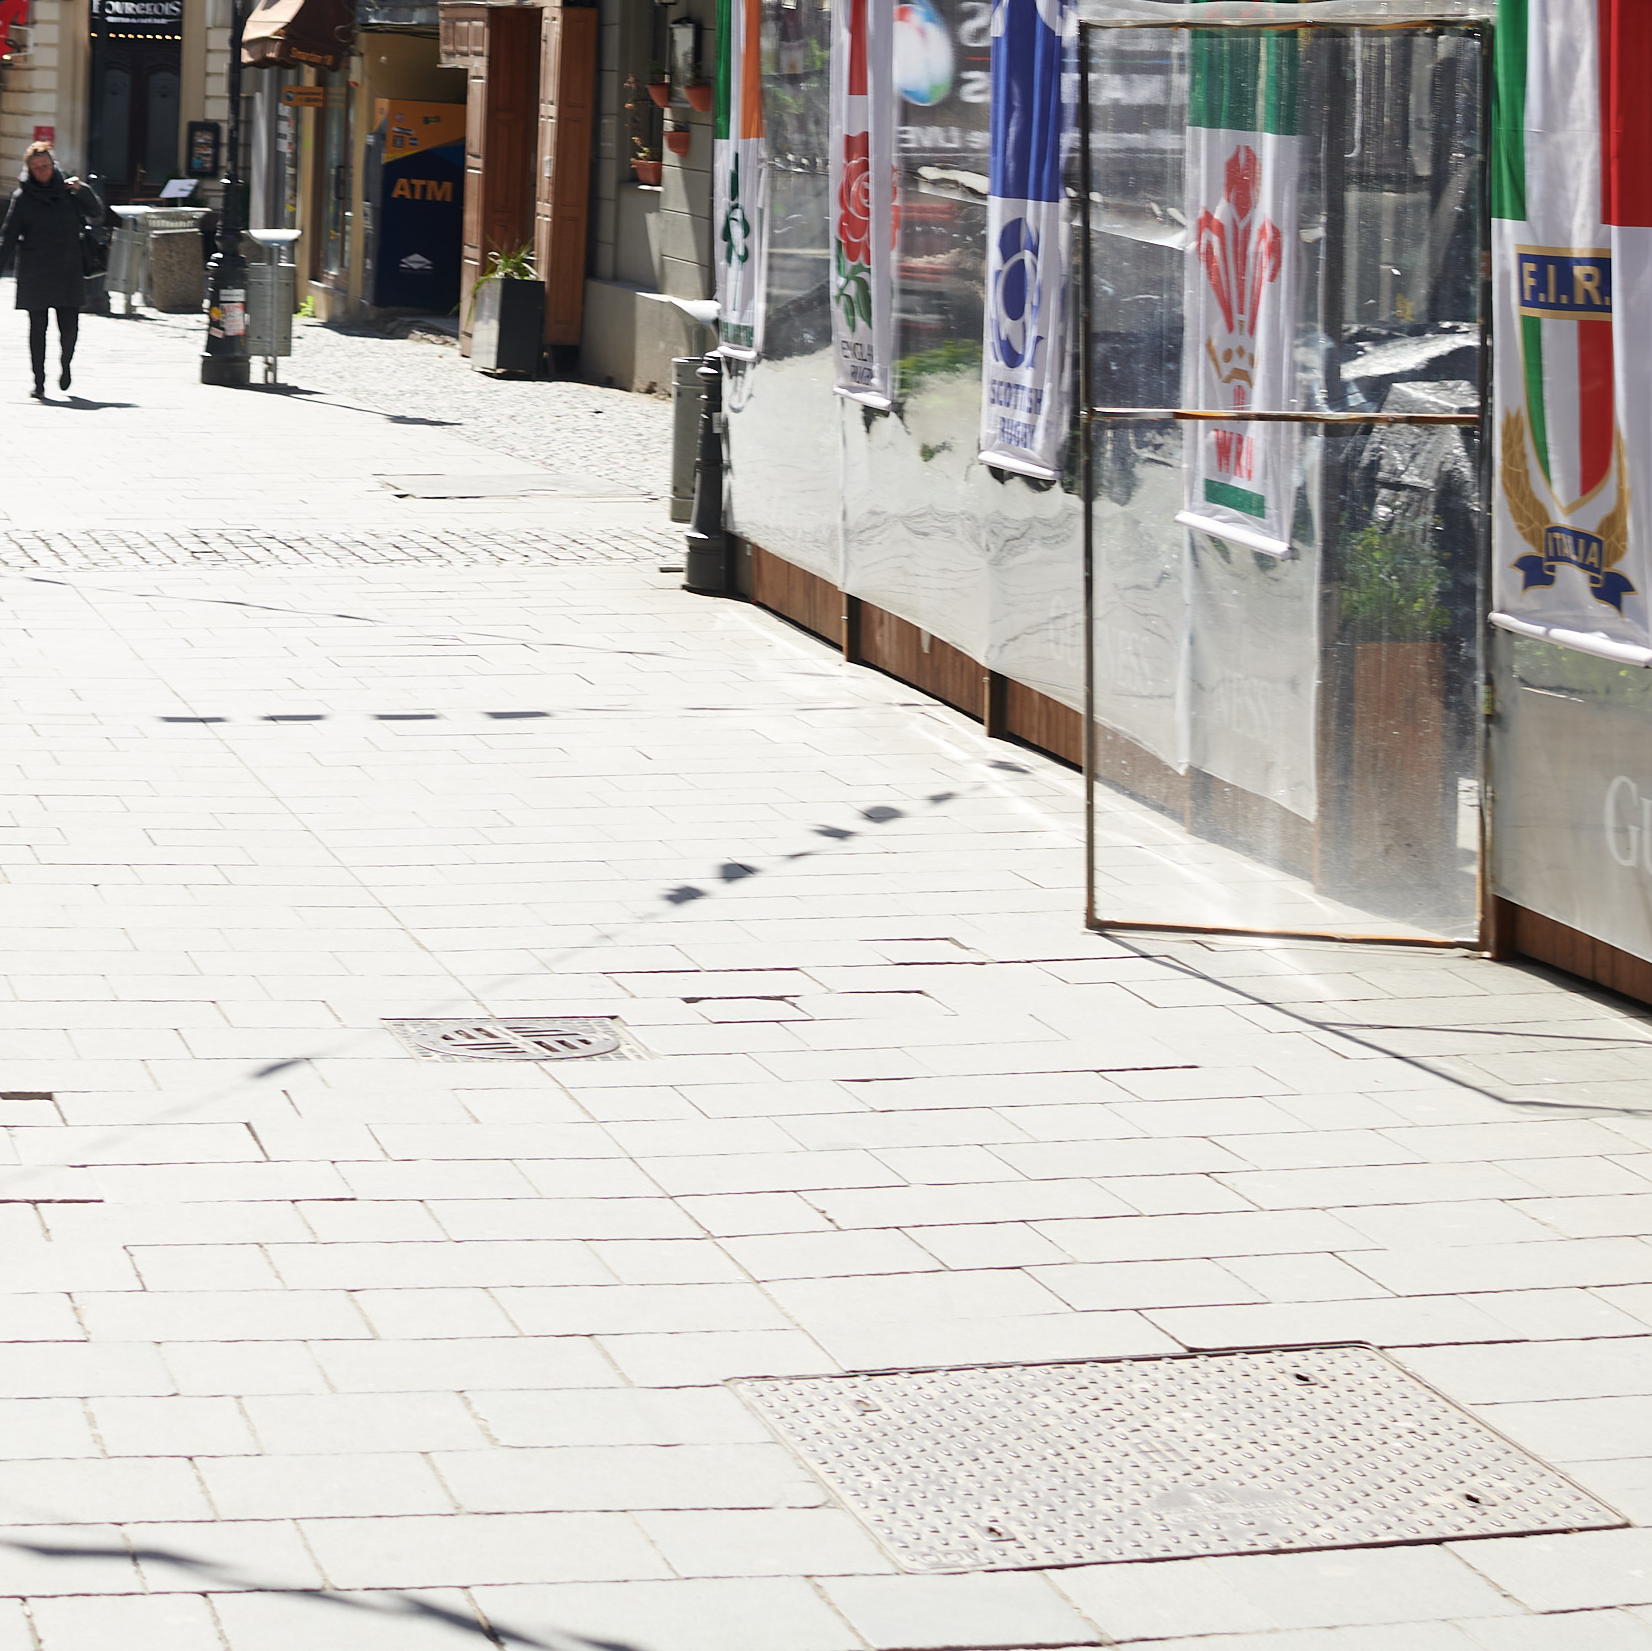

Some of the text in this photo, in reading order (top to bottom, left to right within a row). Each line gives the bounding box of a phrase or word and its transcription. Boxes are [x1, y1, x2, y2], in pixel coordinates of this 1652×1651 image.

[391, 176, 454, 201] ATM
[1522, 258, 1612, 306] F.I.R.
[1548, 527, 1605, 571] ITALIA
